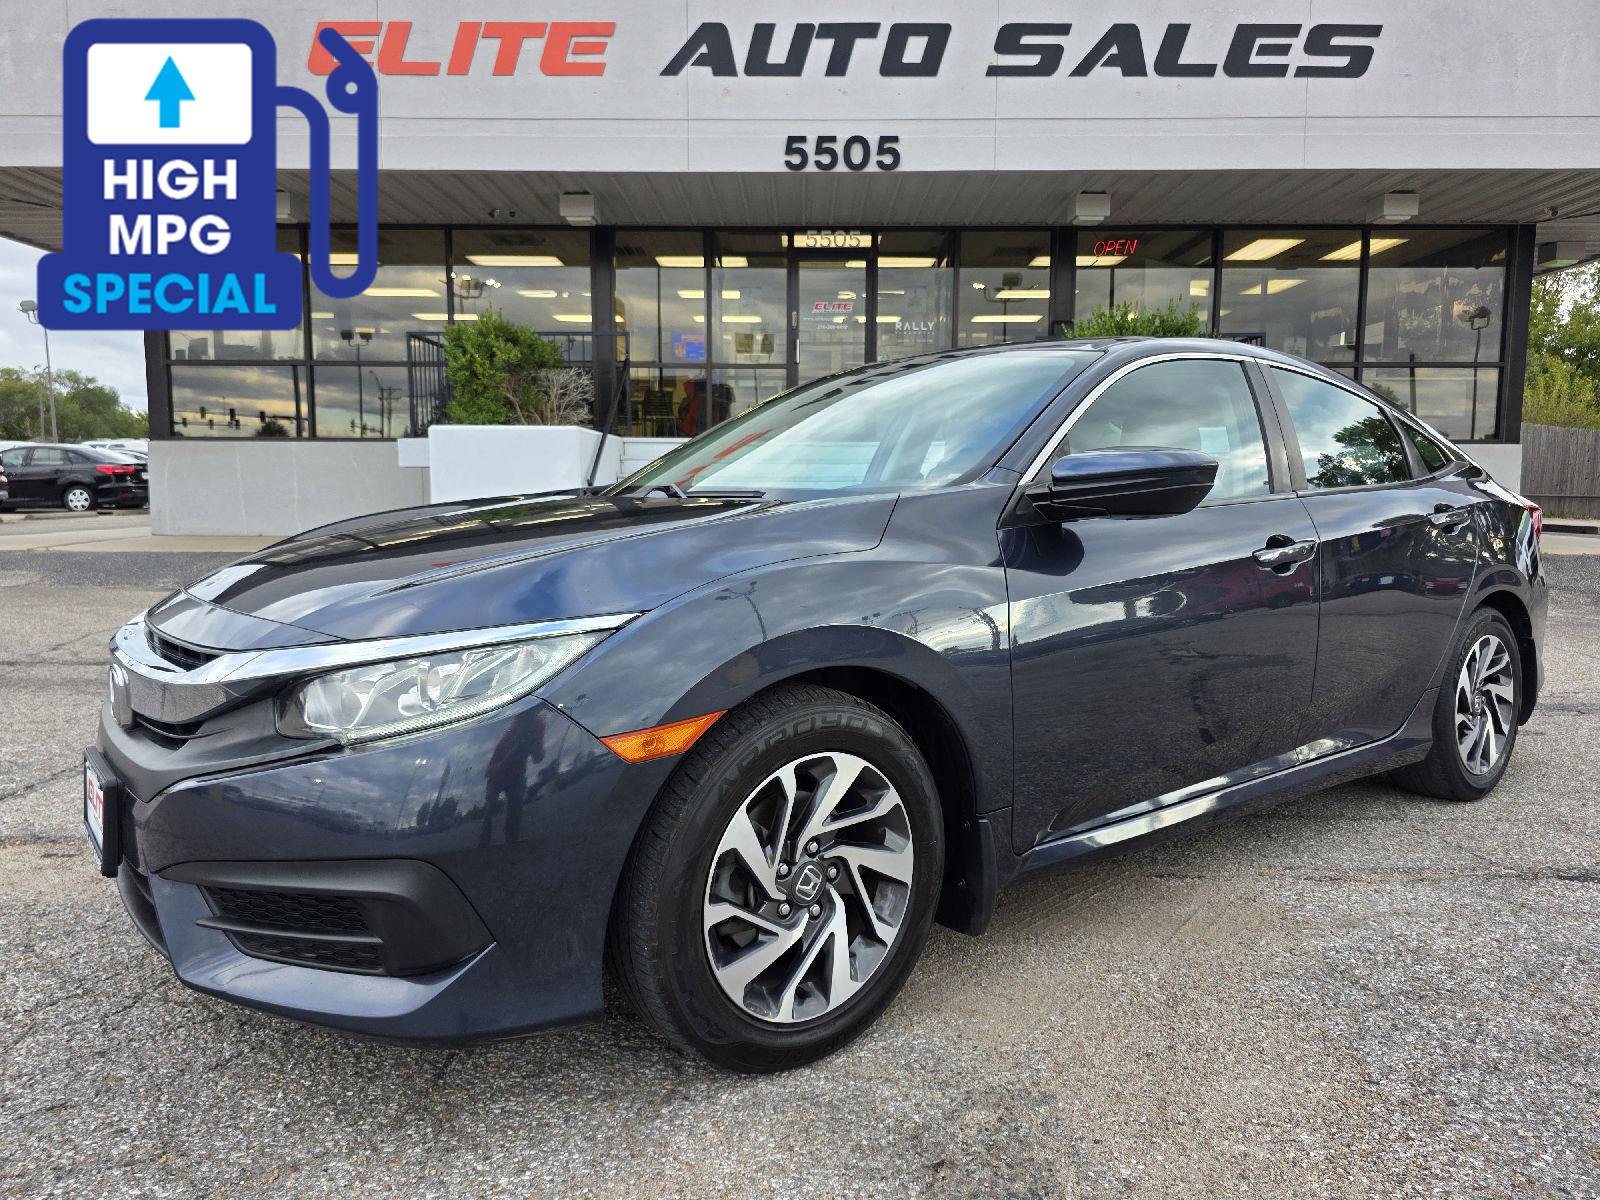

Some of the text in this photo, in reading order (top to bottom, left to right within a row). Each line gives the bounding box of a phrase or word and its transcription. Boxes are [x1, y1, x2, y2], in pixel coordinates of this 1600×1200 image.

[307, 21, 1384, 78] ELITE AUTO SALES
[784, 135, 901, 172] 5505
[806, 230, 861, 248] 5505
[1093, 239, 1138, 257] OPEN
[813, 301, 854, 311] ELITE
[895, 321, 935, 331] RALLY
